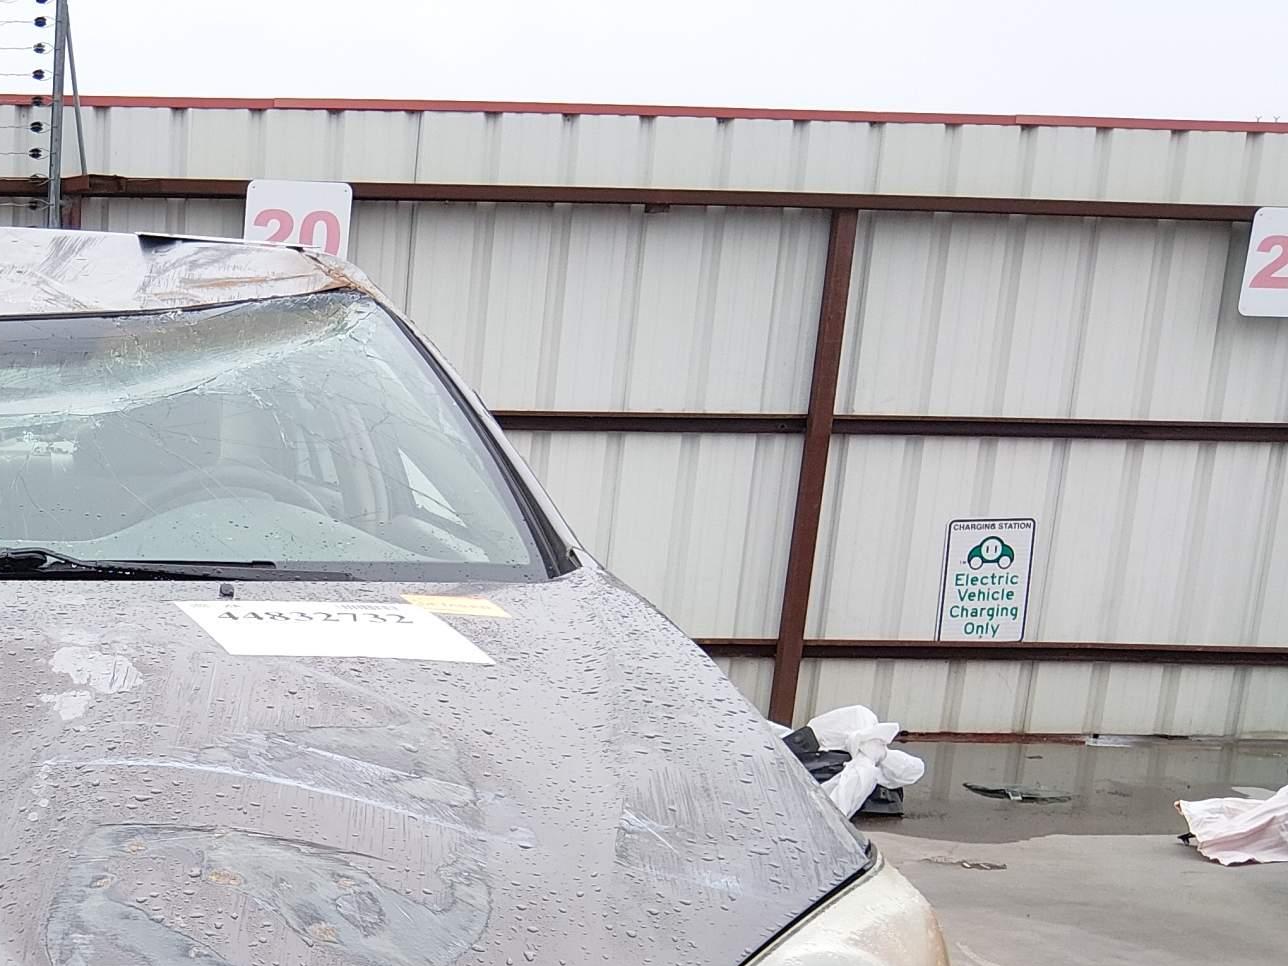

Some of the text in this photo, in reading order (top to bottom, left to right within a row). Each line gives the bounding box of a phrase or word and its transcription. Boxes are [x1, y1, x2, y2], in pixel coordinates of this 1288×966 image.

[253, 208, 341, 256] 20
[953, 522, 1032, 531] CHARGING STATION
[954, 572, 1019, 587] Electric
[957, 587, 1015, 602] Vehicle
[217, 611, 414, 624] 44832732
[949, 604, 1019, 621] Charging
[963, 621, 1000, 639] Only
